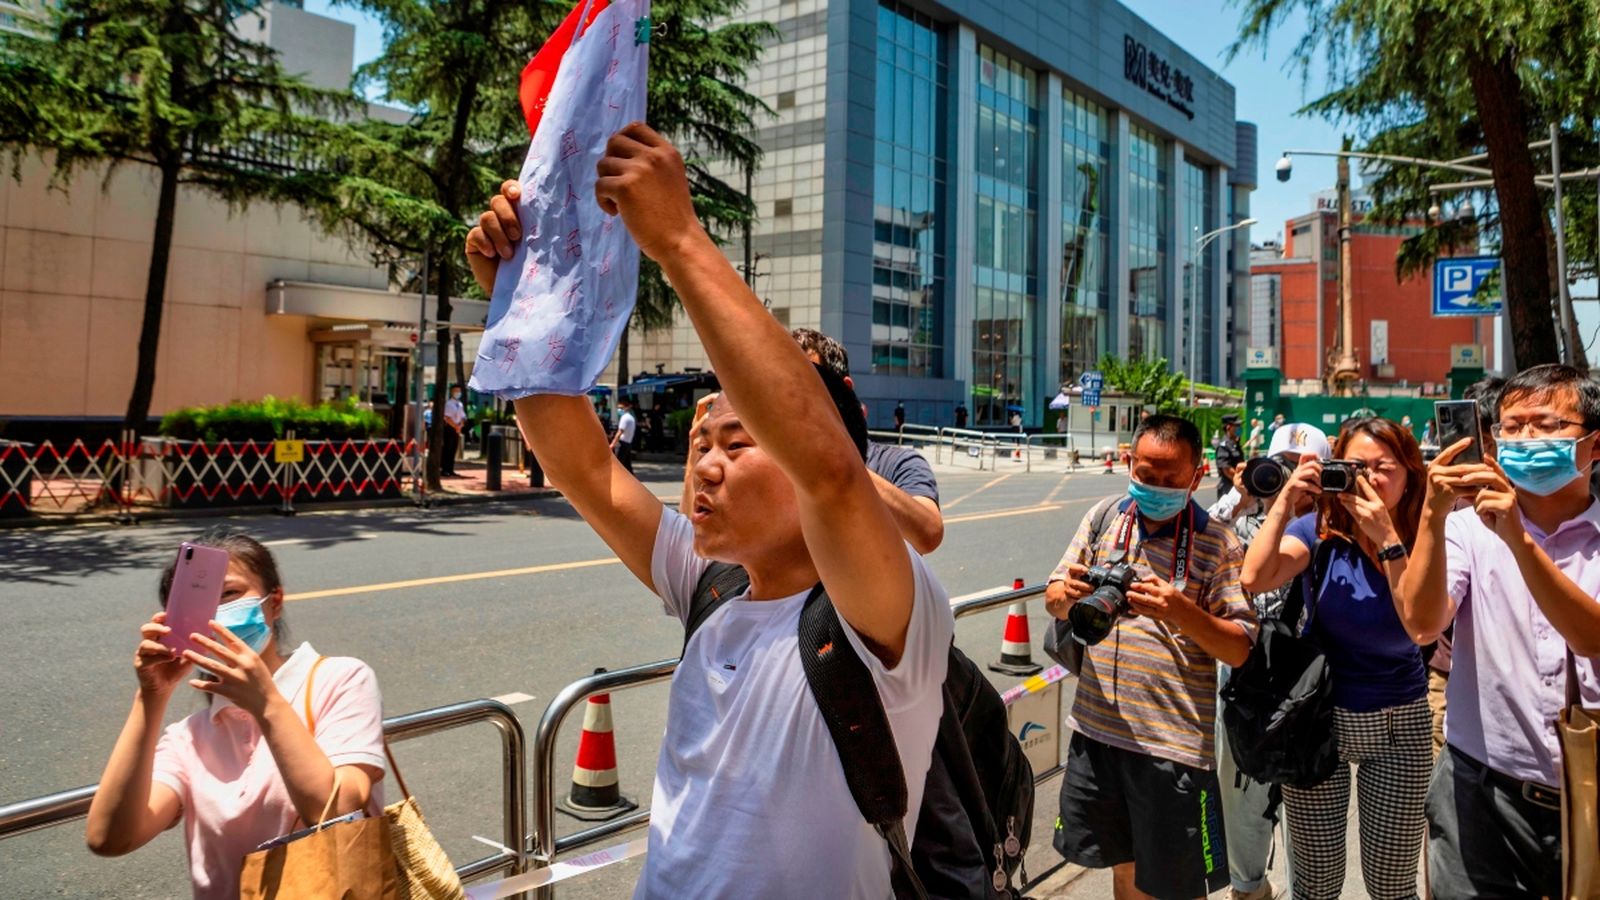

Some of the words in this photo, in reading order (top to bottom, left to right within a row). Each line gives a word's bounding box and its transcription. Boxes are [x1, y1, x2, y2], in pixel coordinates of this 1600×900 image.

[1448, 269, 1468, 290] P
[1175, 559, 1185, 578] EOS
[1200, 790, 1213, 874] ARMOUR
